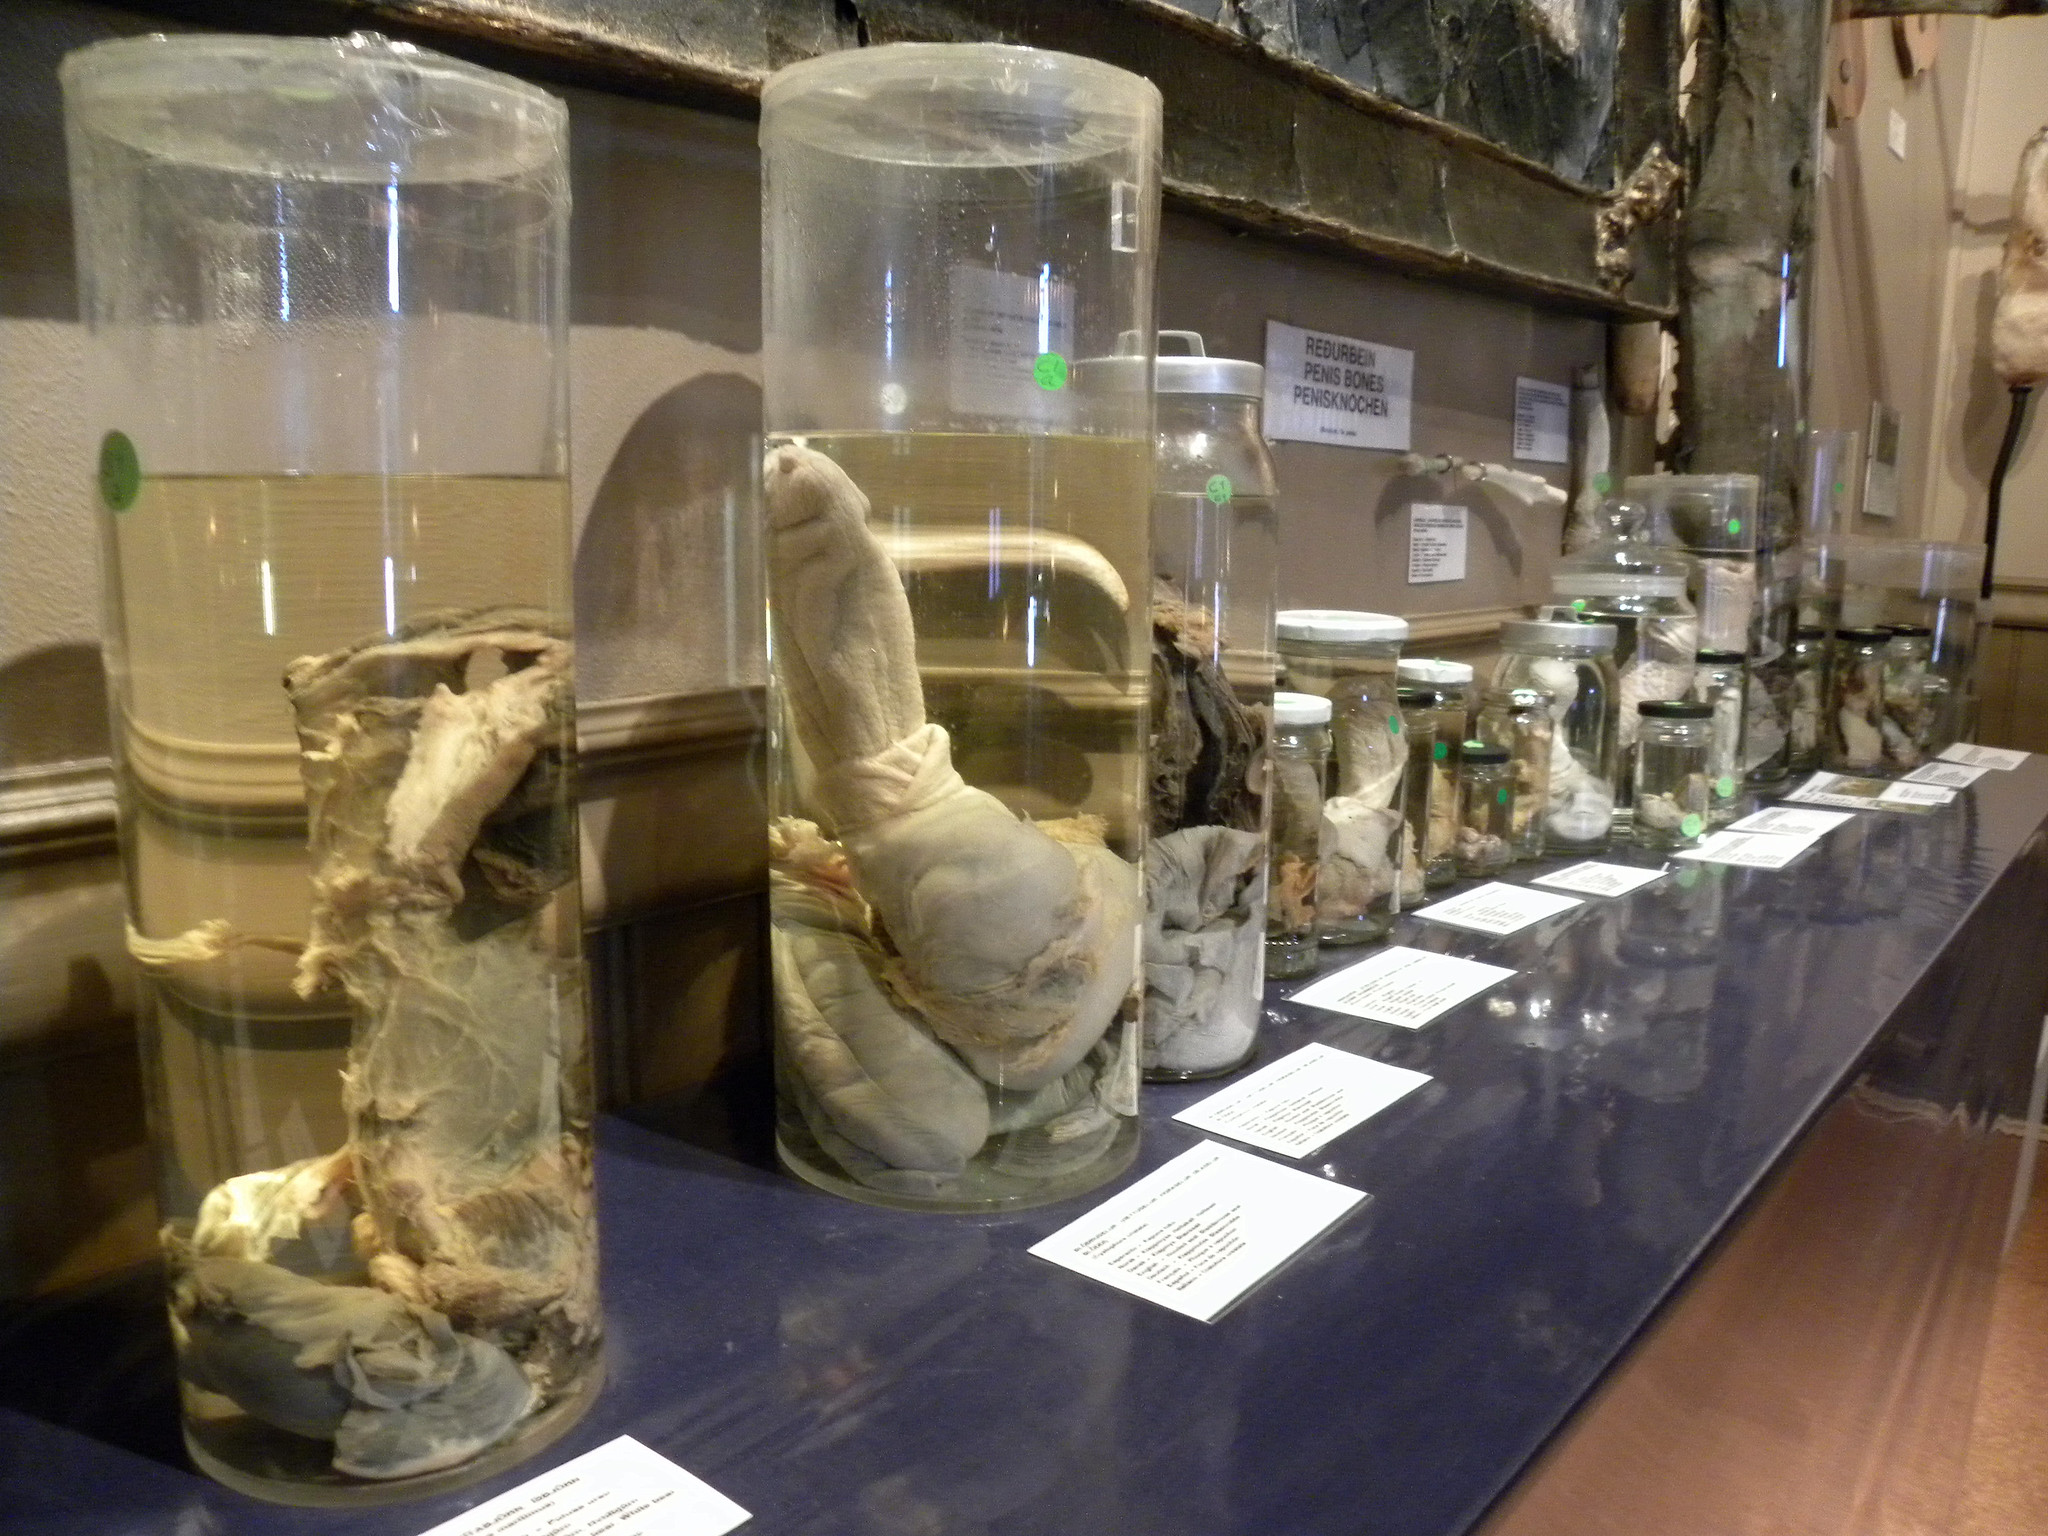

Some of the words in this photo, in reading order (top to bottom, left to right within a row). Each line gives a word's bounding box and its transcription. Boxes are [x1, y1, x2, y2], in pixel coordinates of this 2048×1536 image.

[1304, 361, 1341, 386] PENIS
[1344, 368, 1384, 394] BONES
[1294, 385, 1388, 417] PENISKNOCHEN
